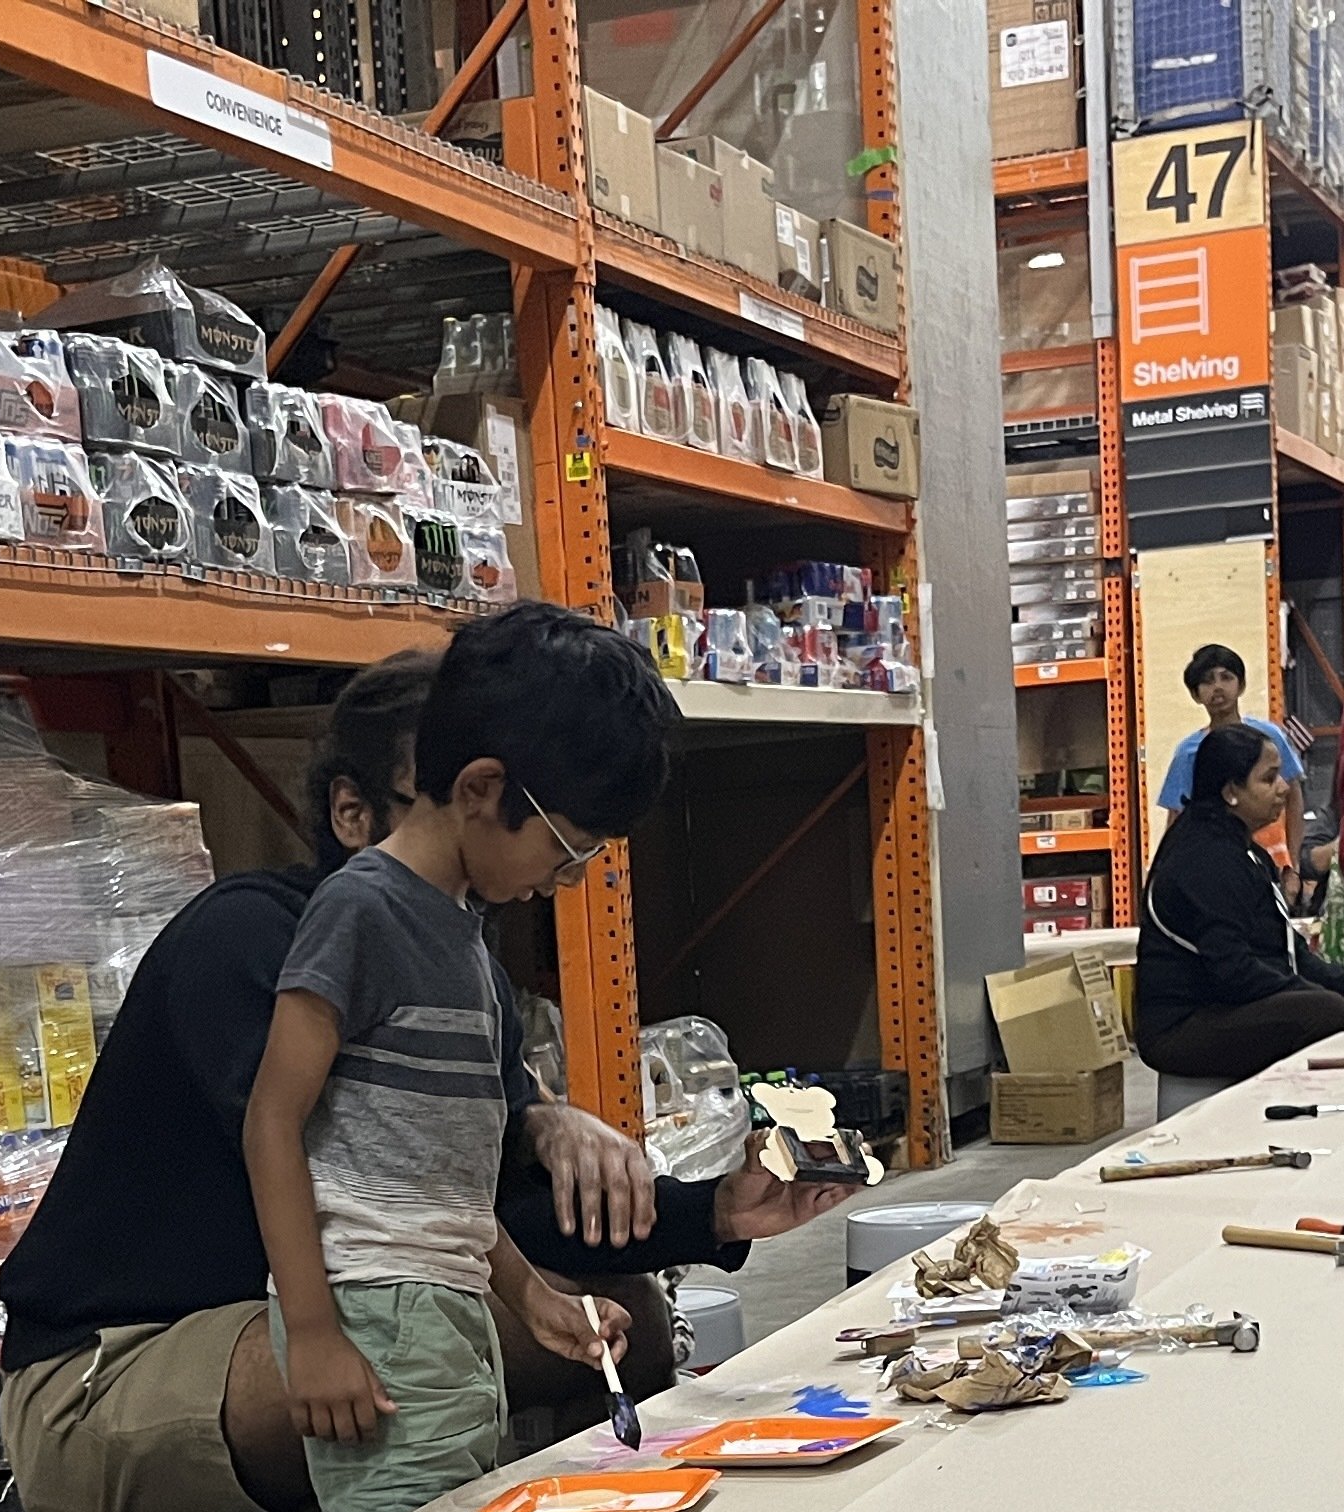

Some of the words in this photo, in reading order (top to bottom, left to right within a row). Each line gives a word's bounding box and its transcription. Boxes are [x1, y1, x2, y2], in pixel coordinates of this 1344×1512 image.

[205, 90, 283, 137] CONVENIENCE
[1146, 136, 1247, 224] 47
[1133, 354, 1239, 387] Shelving
[1132, 408, 1174, 428] Metal
[1176, 401, 1238, 424] Shelving
